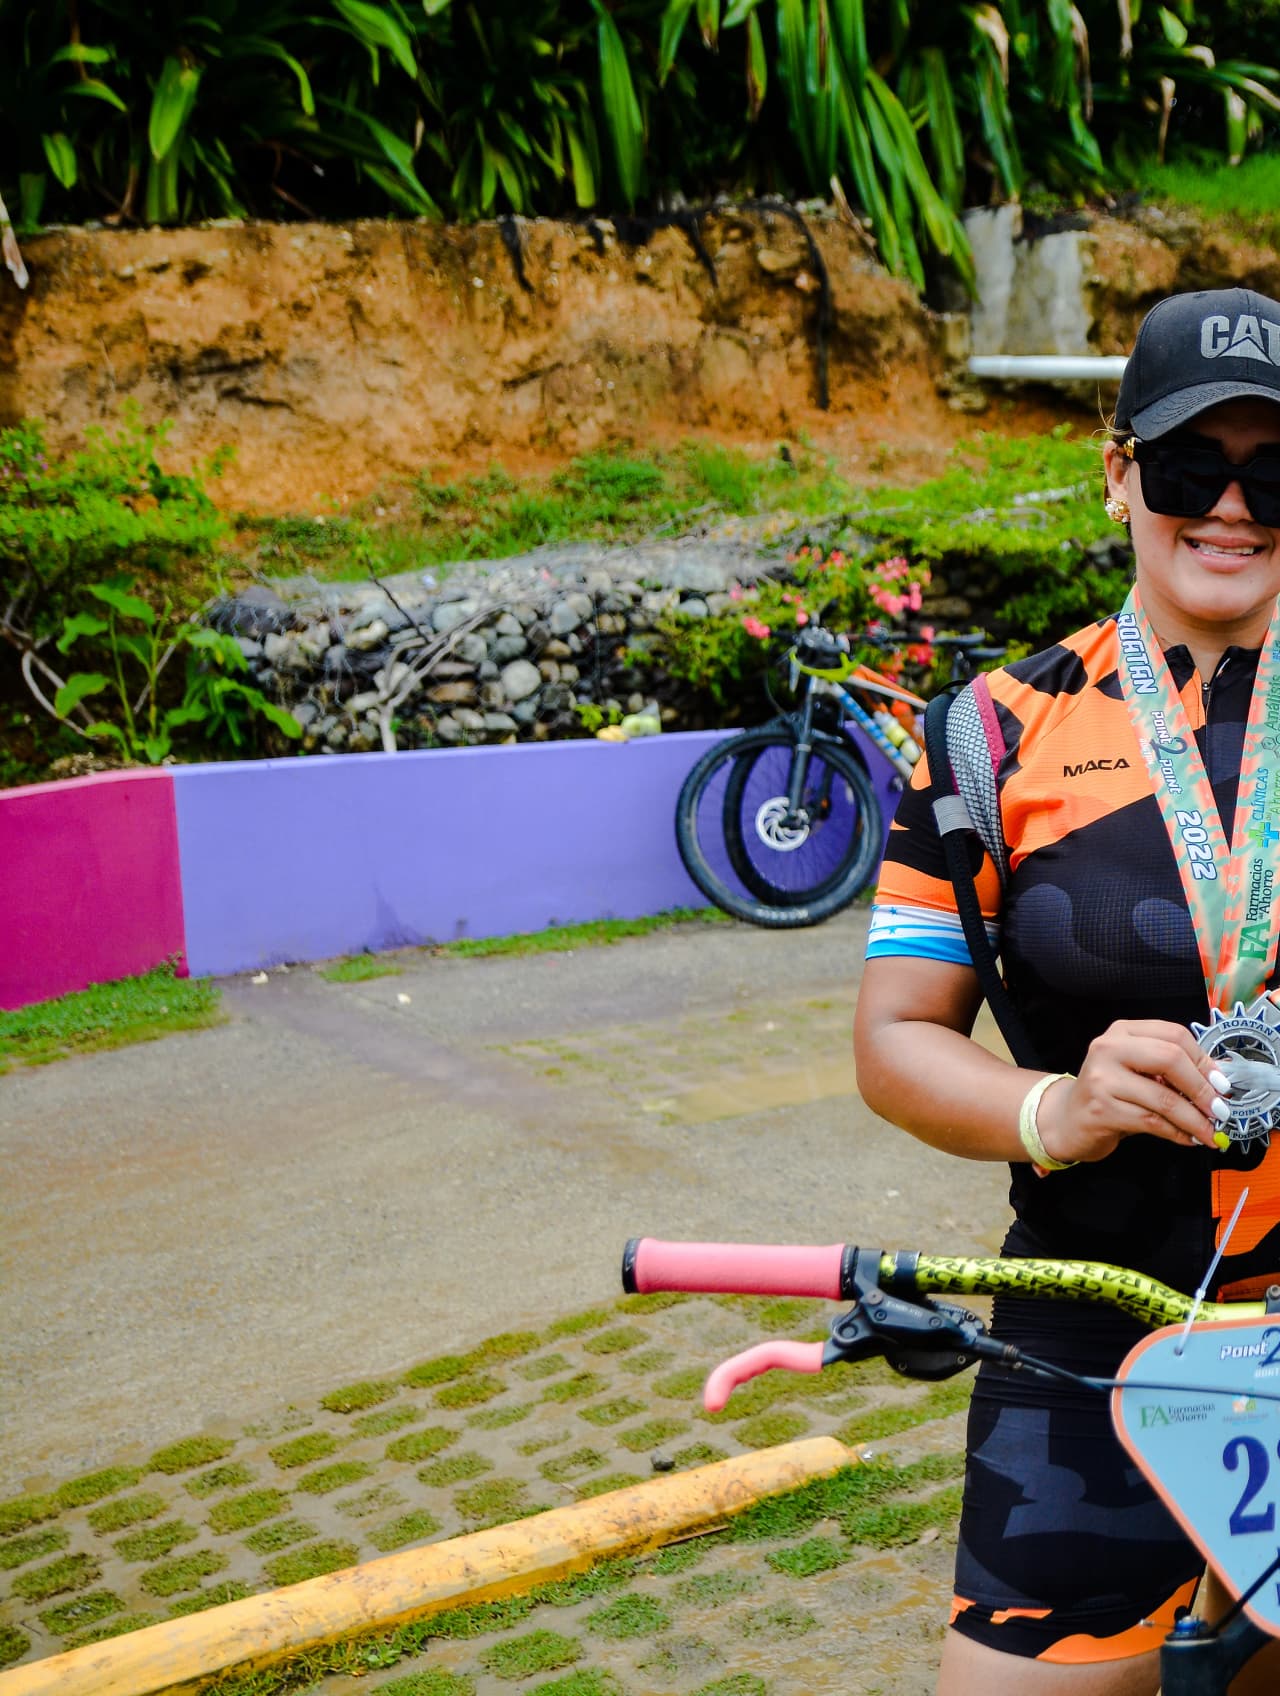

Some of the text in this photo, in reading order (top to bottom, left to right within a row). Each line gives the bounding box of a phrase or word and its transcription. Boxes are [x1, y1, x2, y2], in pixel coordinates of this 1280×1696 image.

[1117, 612, 1159, 695] ROATAN
[1063, 758, 1131, 777] MACA
[1251, 767, 1269, 821] CLÍNICAS
[1175, 810, 1217, 880] 2022
[1246, 858, 1264, 921] Farmacias
[1261, 869, 1274, 914] Ahorro
[1237, 920, 1271, 962] FA
[1222, 1020, 1274, 1037] ROATAN
[1232, 1106, 1262, 1117] POINT
[1140, 1404, 1170, 1428] FA
[1168, 1402, 1216, 1414] Farmacias
[1175, 1413, 1208, 1423] Ahorro
